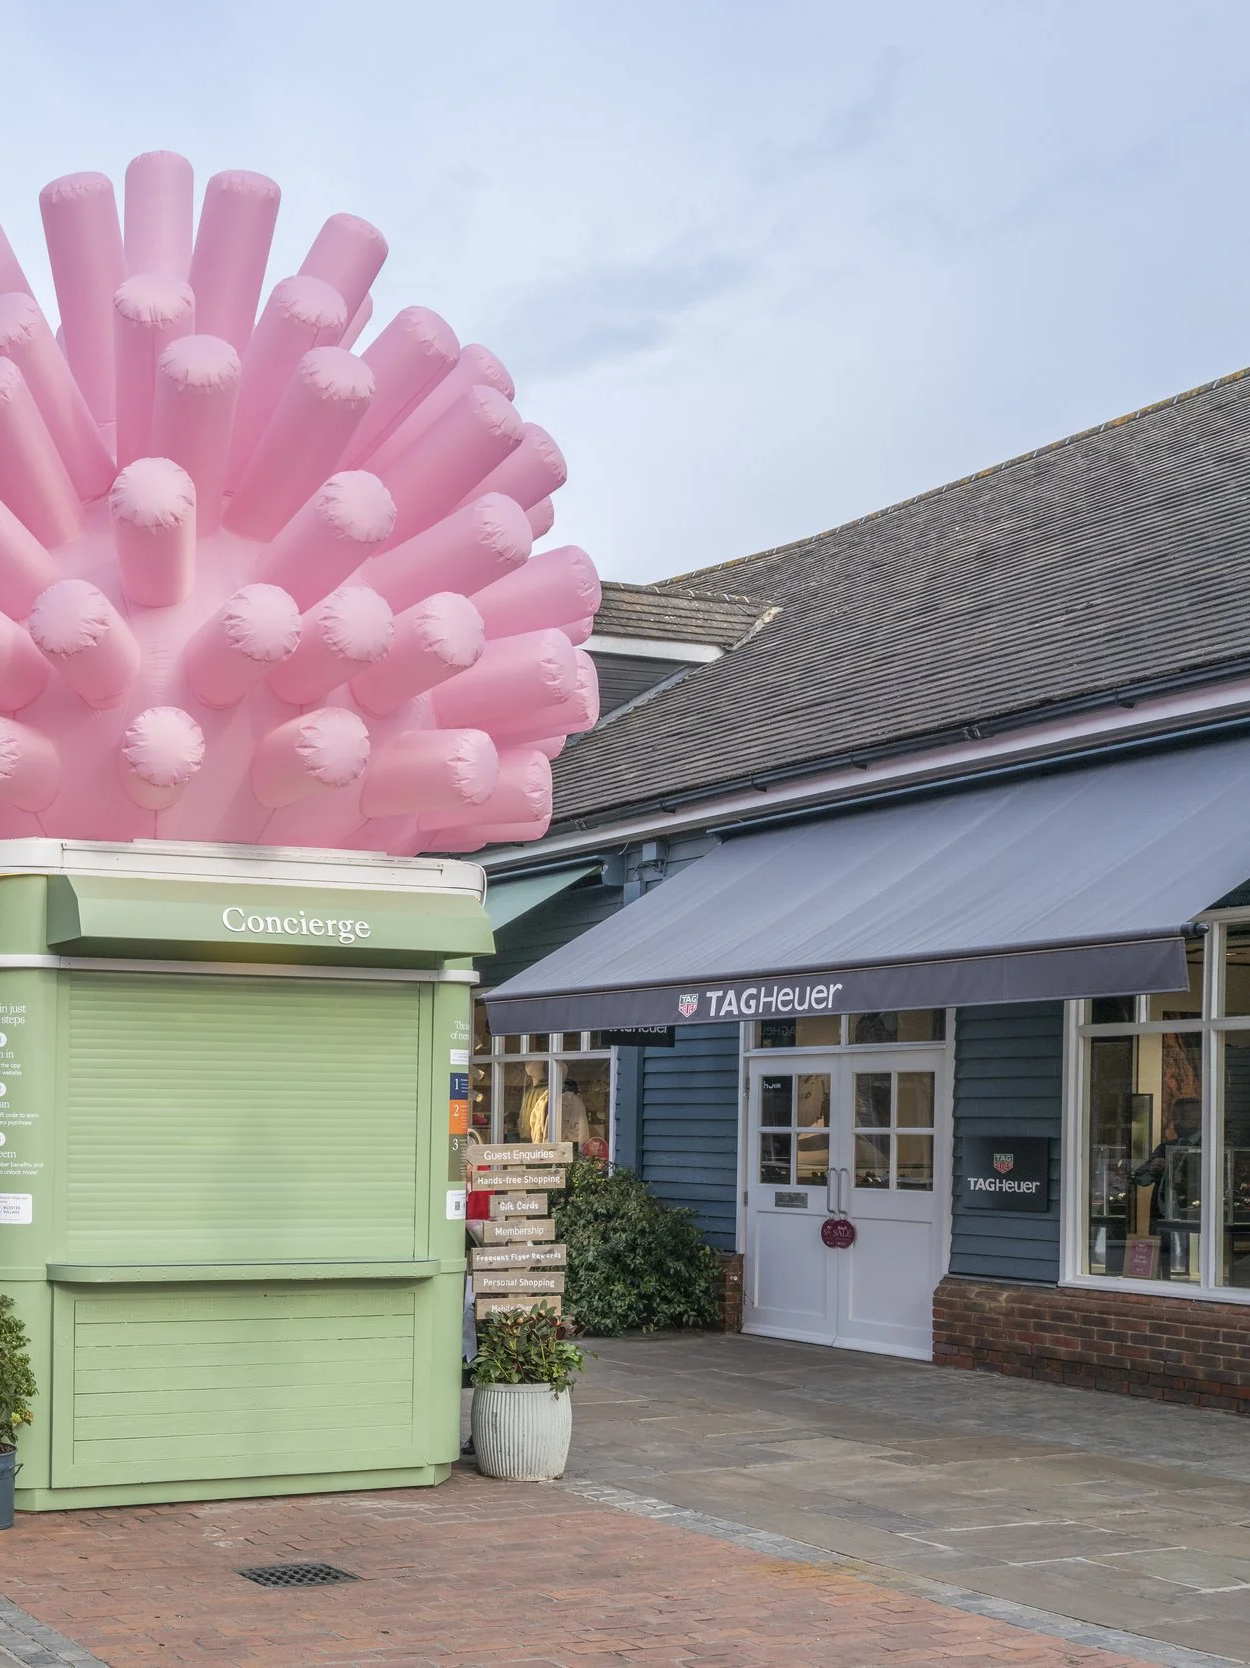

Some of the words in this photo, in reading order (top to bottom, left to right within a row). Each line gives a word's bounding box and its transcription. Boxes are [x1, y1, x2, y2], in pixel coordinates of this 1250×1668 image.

[222, 907, 371, 944] Concierge
[681, 995, 697, 1004] TAG
[0, 1003, 8, 1013] in
[9, 1003, 27, 1016] just
[1, 1015, 25, 1027] steps
[454, 1020, 466, 1029] The
[5, 1049, 14, 1058] in
[455, 1078, 459, 1090] 1
[453, 1104, 459, 1116] 2
[452, 1138, 459, 1151] 3
[483, 1150, 511, 1160] Guest
[513, 1149, 554, 1160] Enquiries
[477, 1175, 522, 1185] Hands-free
[523, 1175, 560, 1185] Shopping
[499, 1201, 515, 1211] Gift
[516, 1201, 539, 1210] Cards
[495, 1225, 544, 1236] Membership
[832, 1229, 852, 1237] SALE
[476, 1254, 509, 1262] Frequent
[510, 1253, 529, 1261] Flyer
[531, 1251, 562, 1259] Rewards
[483, 1278, 517, 1287] Personal
[519, 1278, 555, 1288] Shopping
